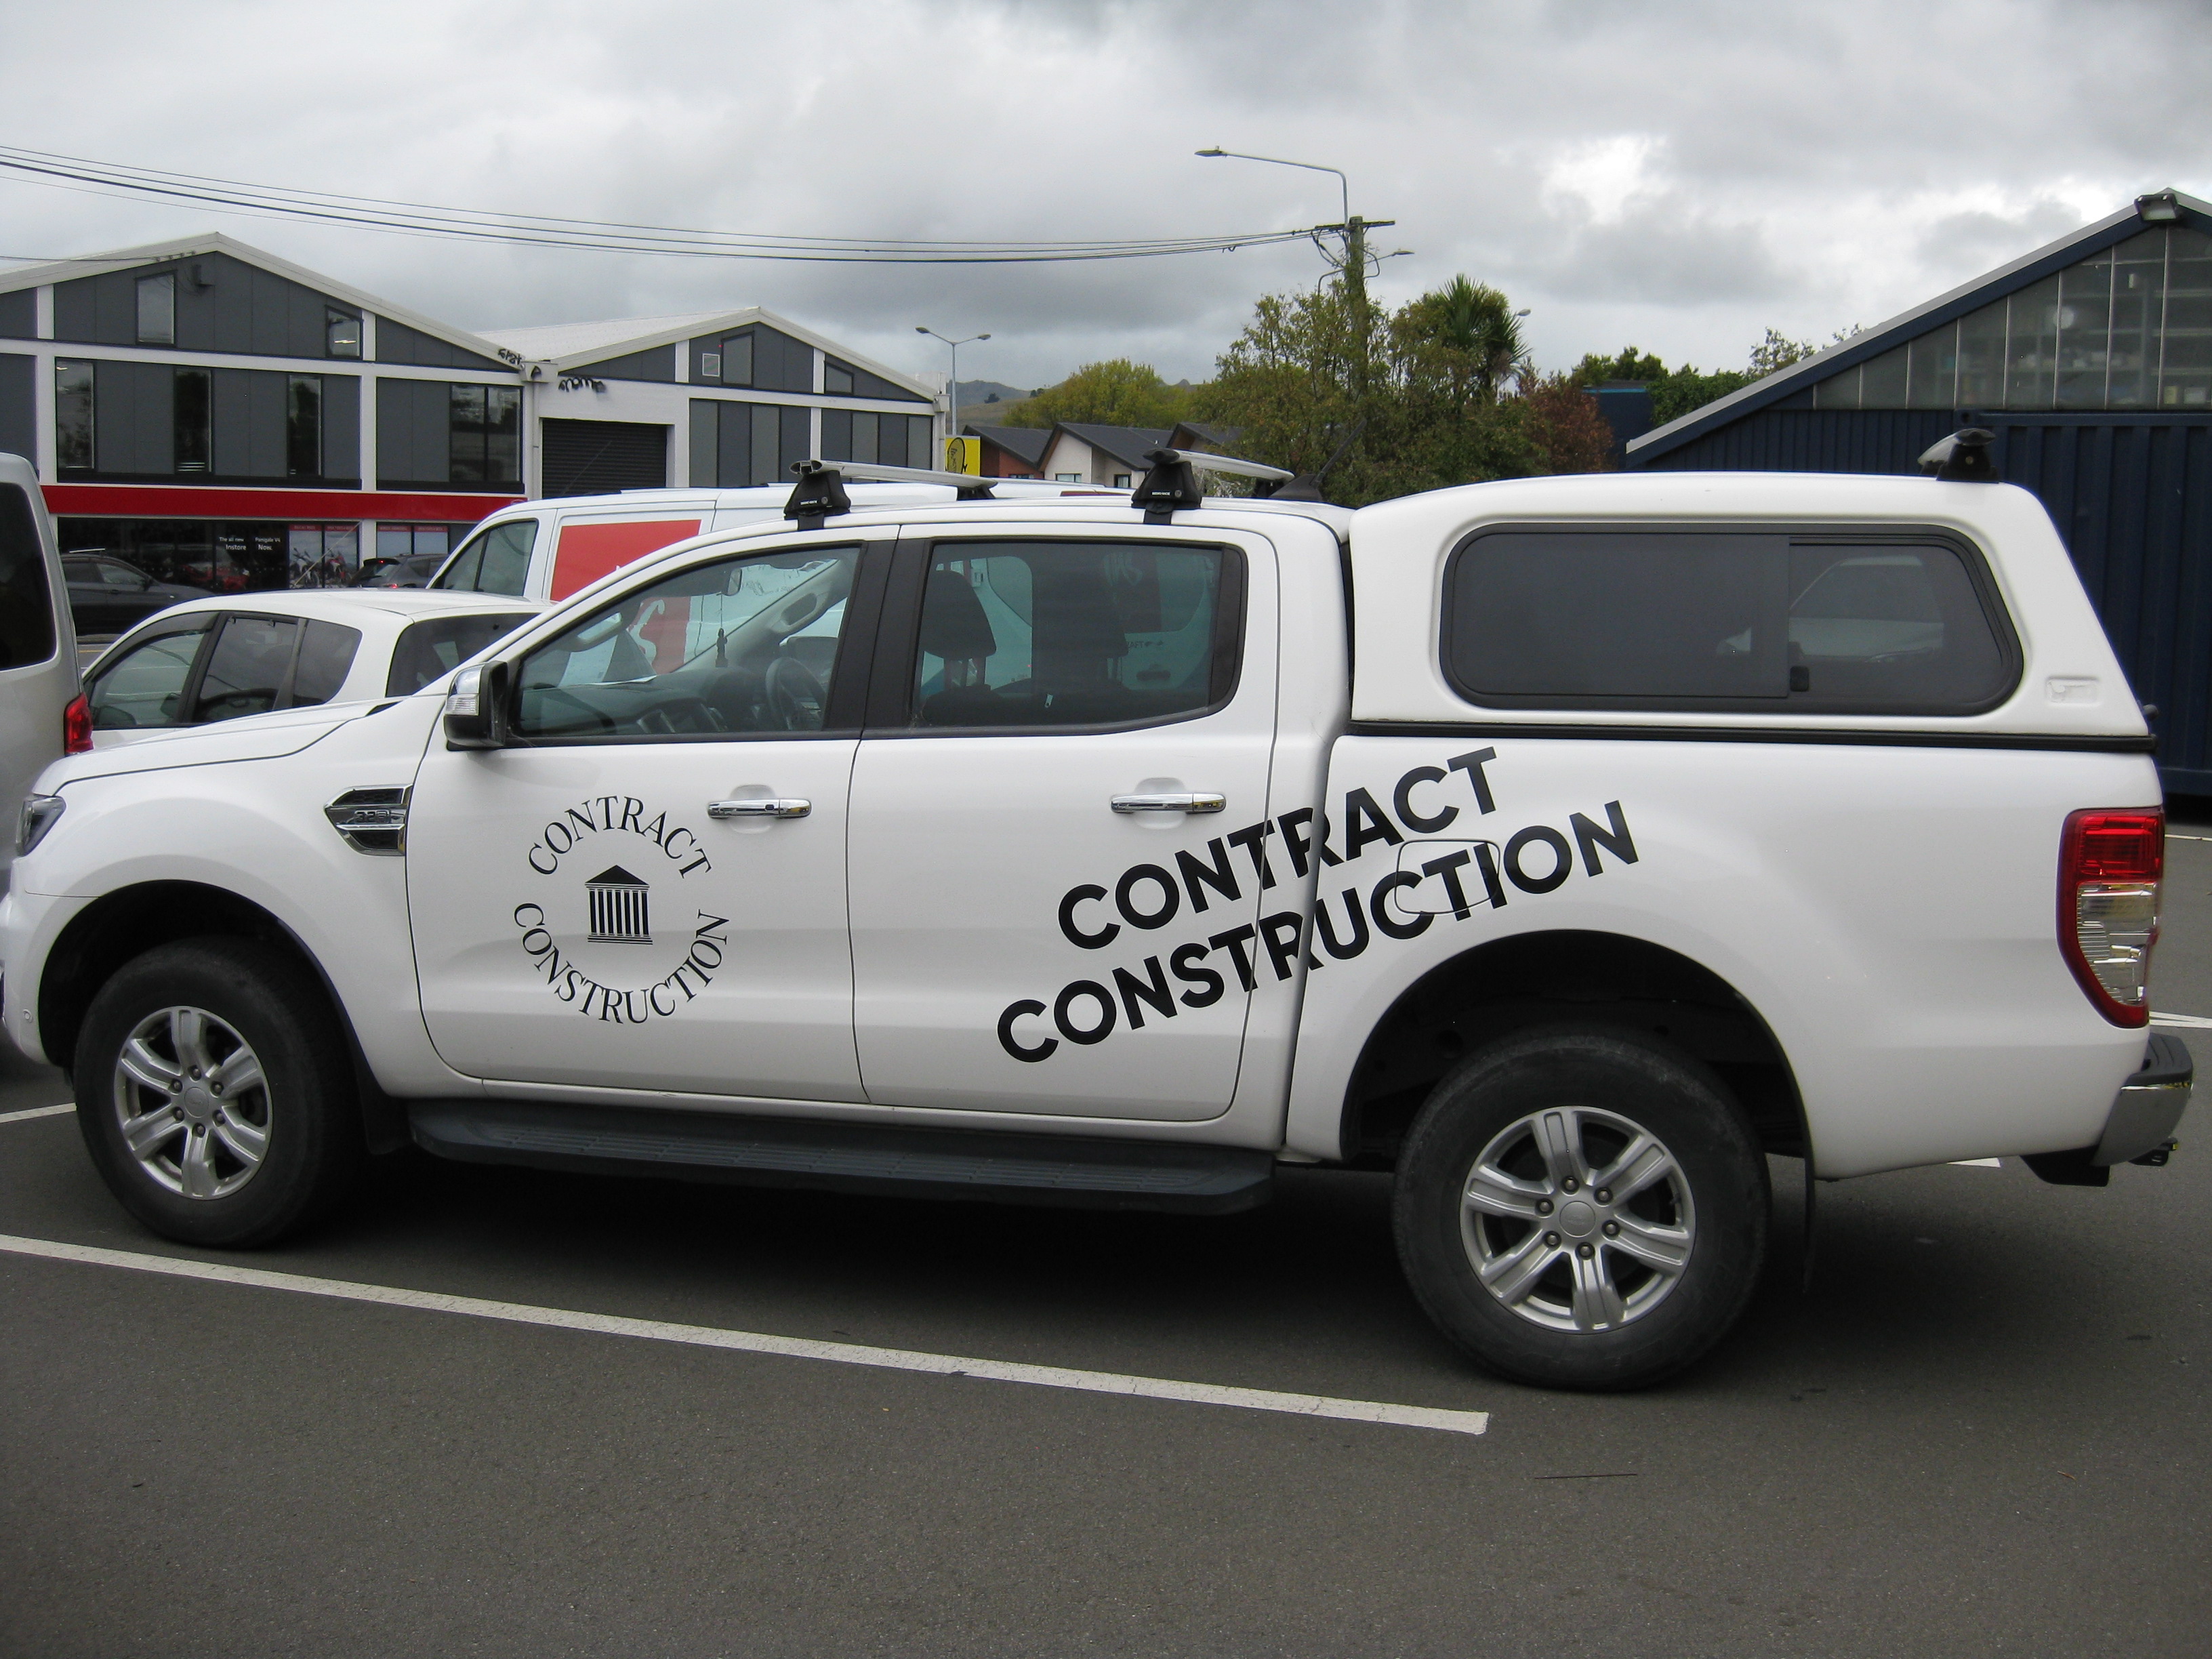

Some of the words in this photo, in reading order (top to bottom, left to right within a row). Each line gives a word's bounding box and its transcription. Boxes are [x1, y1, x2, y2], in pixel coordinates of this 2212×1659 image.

[529, 796, 712, 879] CONTRACT
[1058, 746, 1498, 949] CONTRACT
[514, 903, 730, 1024] CONSTRUCTION
[997, 800, 1639, 1063] CONSTRUCTION
